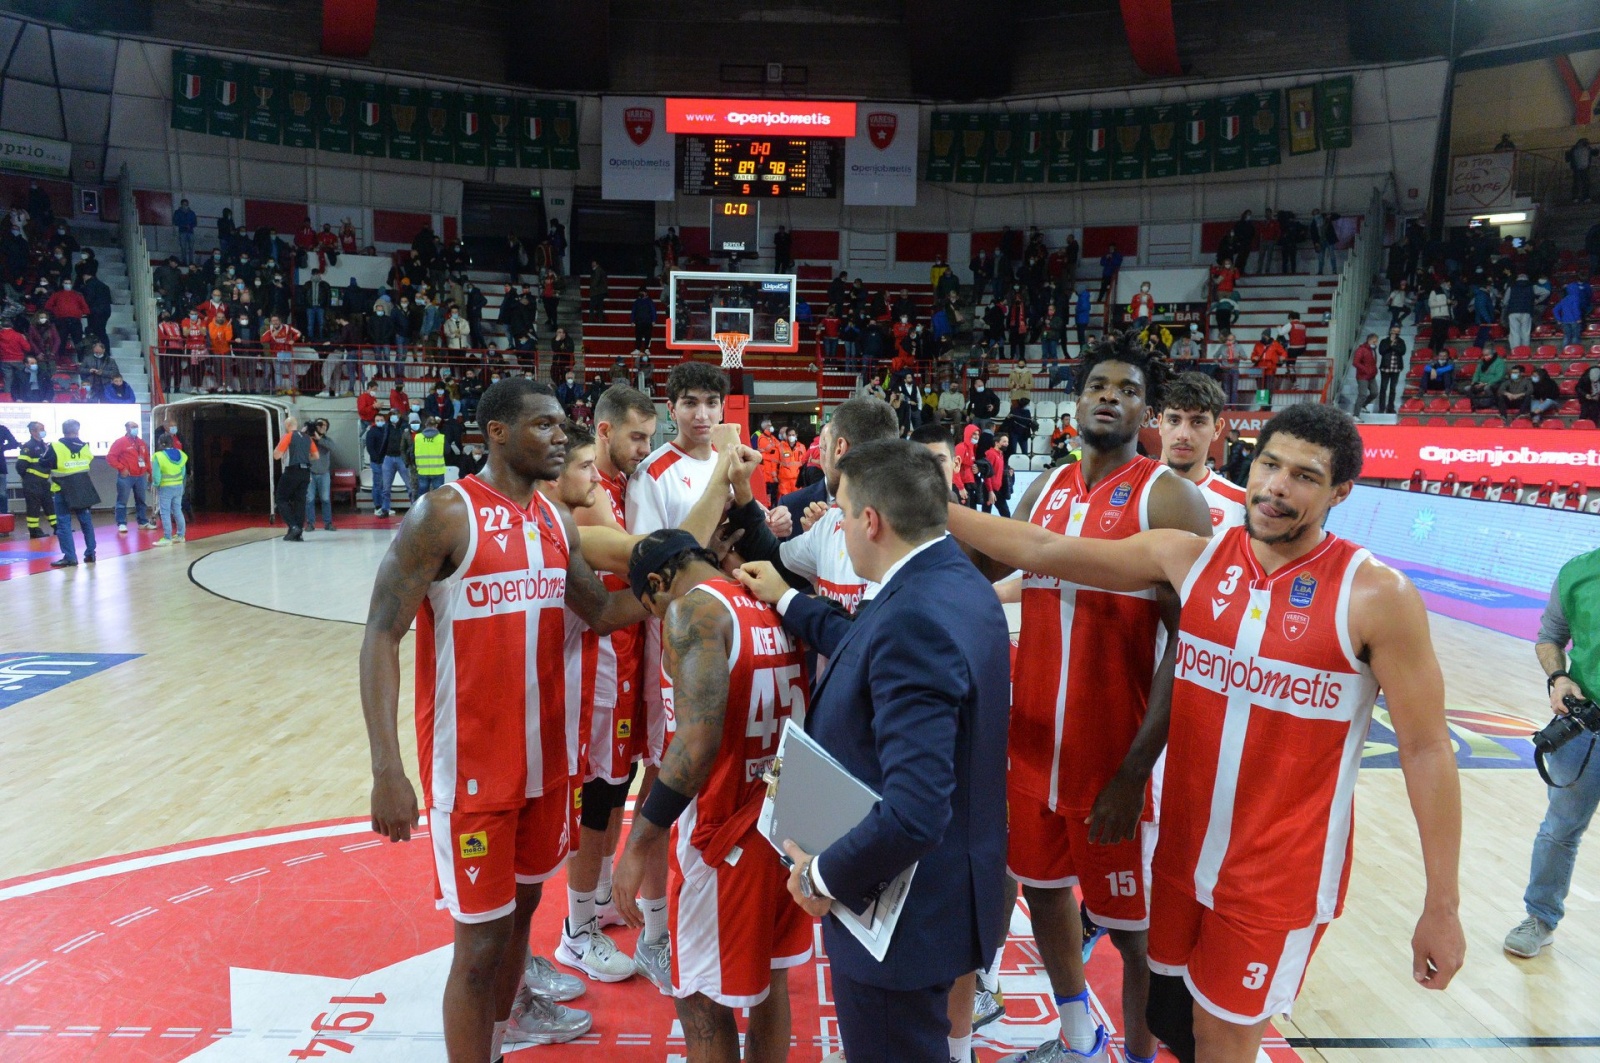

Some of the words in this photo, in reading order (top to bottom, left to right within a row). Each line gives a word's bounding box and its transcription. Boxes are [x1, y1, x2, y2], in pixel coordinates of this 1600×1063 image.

[685, 112, 716, 122] www.
[738, 161, 755, 174] 89
[769, 161, 786, 174] 98
[742, 183, 751, 194] 5
[771, 184, 780, 195] 5
[1176, 312, 1200, 321] BAR
[1046, 488, 1071, 511] 15
[479, 505, 513, 532] 22
[1217, 565, 1243, 595] 3
[745, 664, 806, 750] 45
[1104, 870, 1137, 897] 15
[1242, 962, 1269, 990] 3
